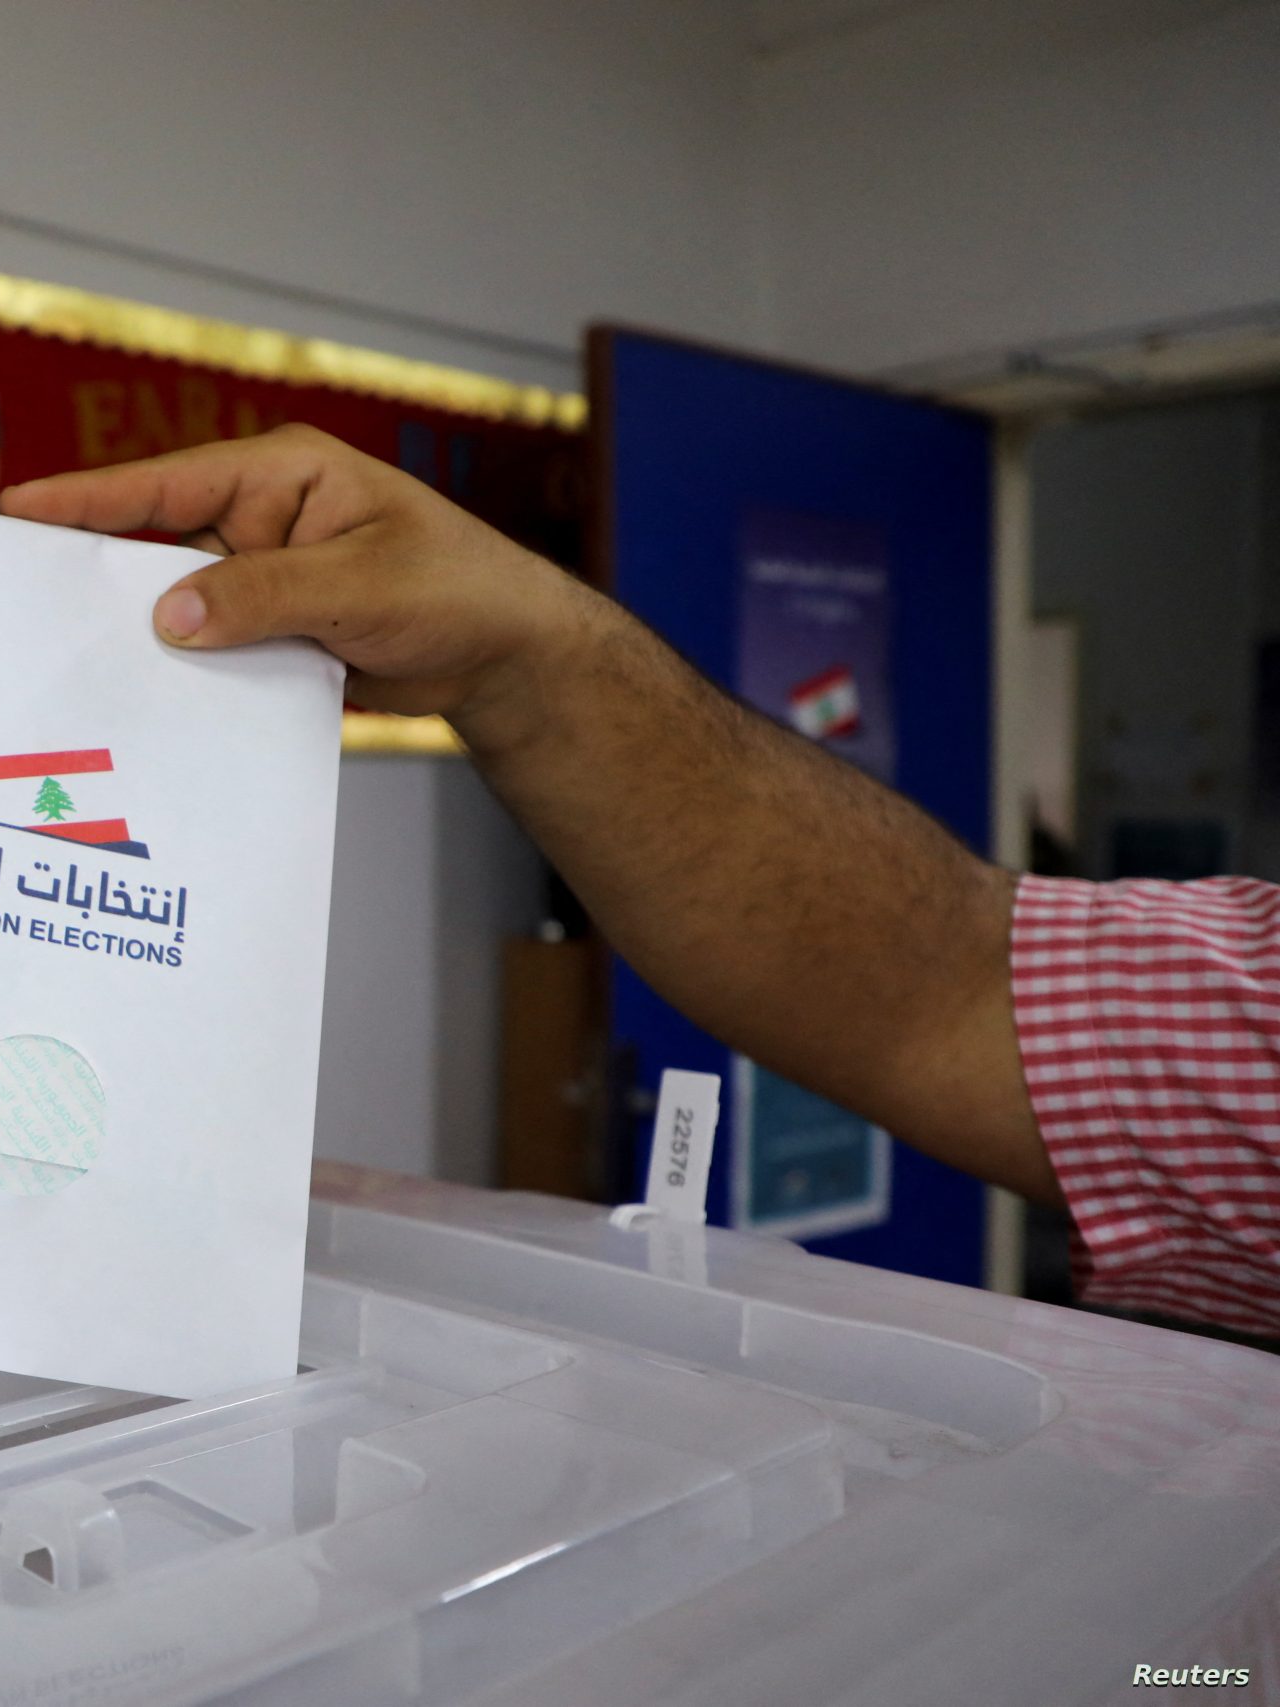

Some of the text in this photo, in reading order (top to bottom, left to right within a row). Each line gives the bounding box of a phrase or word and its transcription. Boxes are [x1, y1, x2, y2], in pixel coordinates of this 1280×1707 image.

[17, 862, 187, 944] إنتخابات
[28, 917, 183, 969] ELECTIONS
[666, 1106, 695, 1188] 22576
